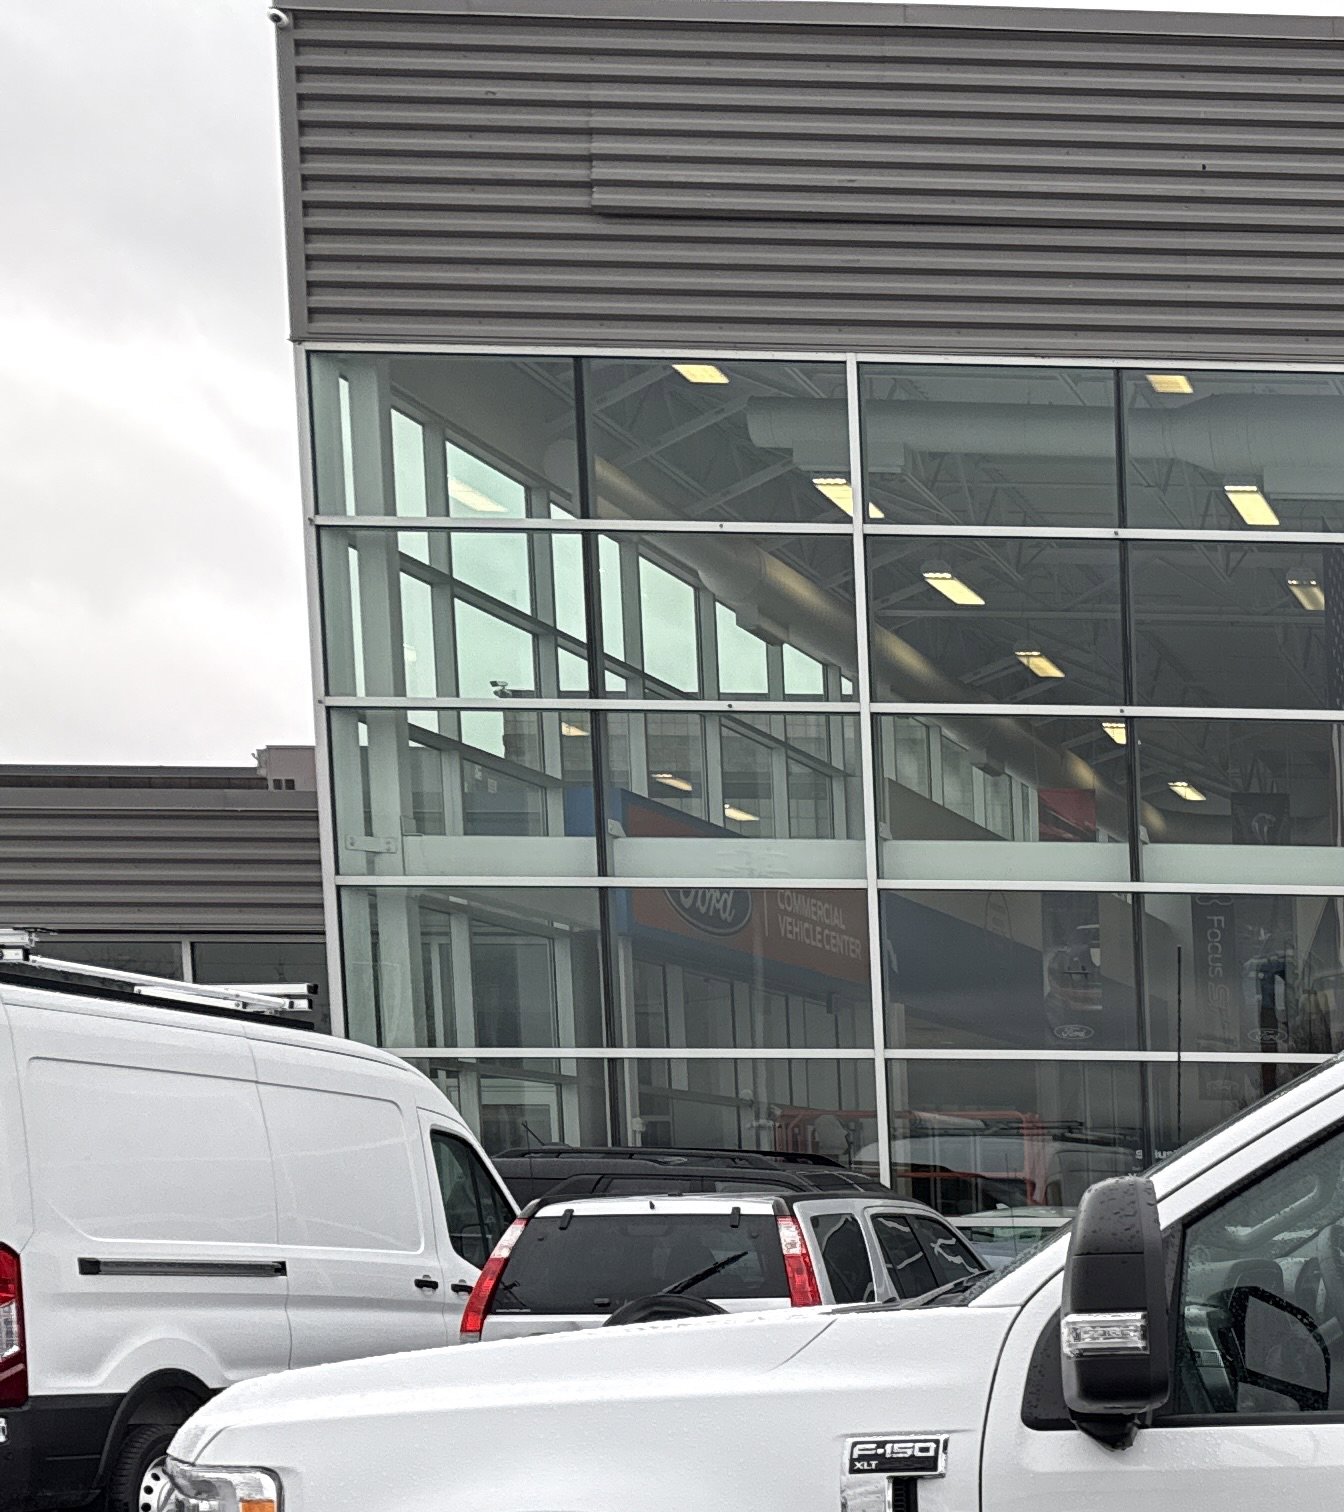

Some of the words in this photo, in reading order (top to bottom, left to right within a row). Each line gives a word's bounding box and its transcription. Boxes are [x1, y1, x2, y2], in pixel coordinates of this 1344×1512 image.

[777, 889, 847, 930] COMMERCIAL
[777, 913, 823, 948] VEHICLE
[823, 931, 862, 959] CENTER
[852, 1442, 937, 1459] F-150
[853, 1460, 879, 1470] XLT
